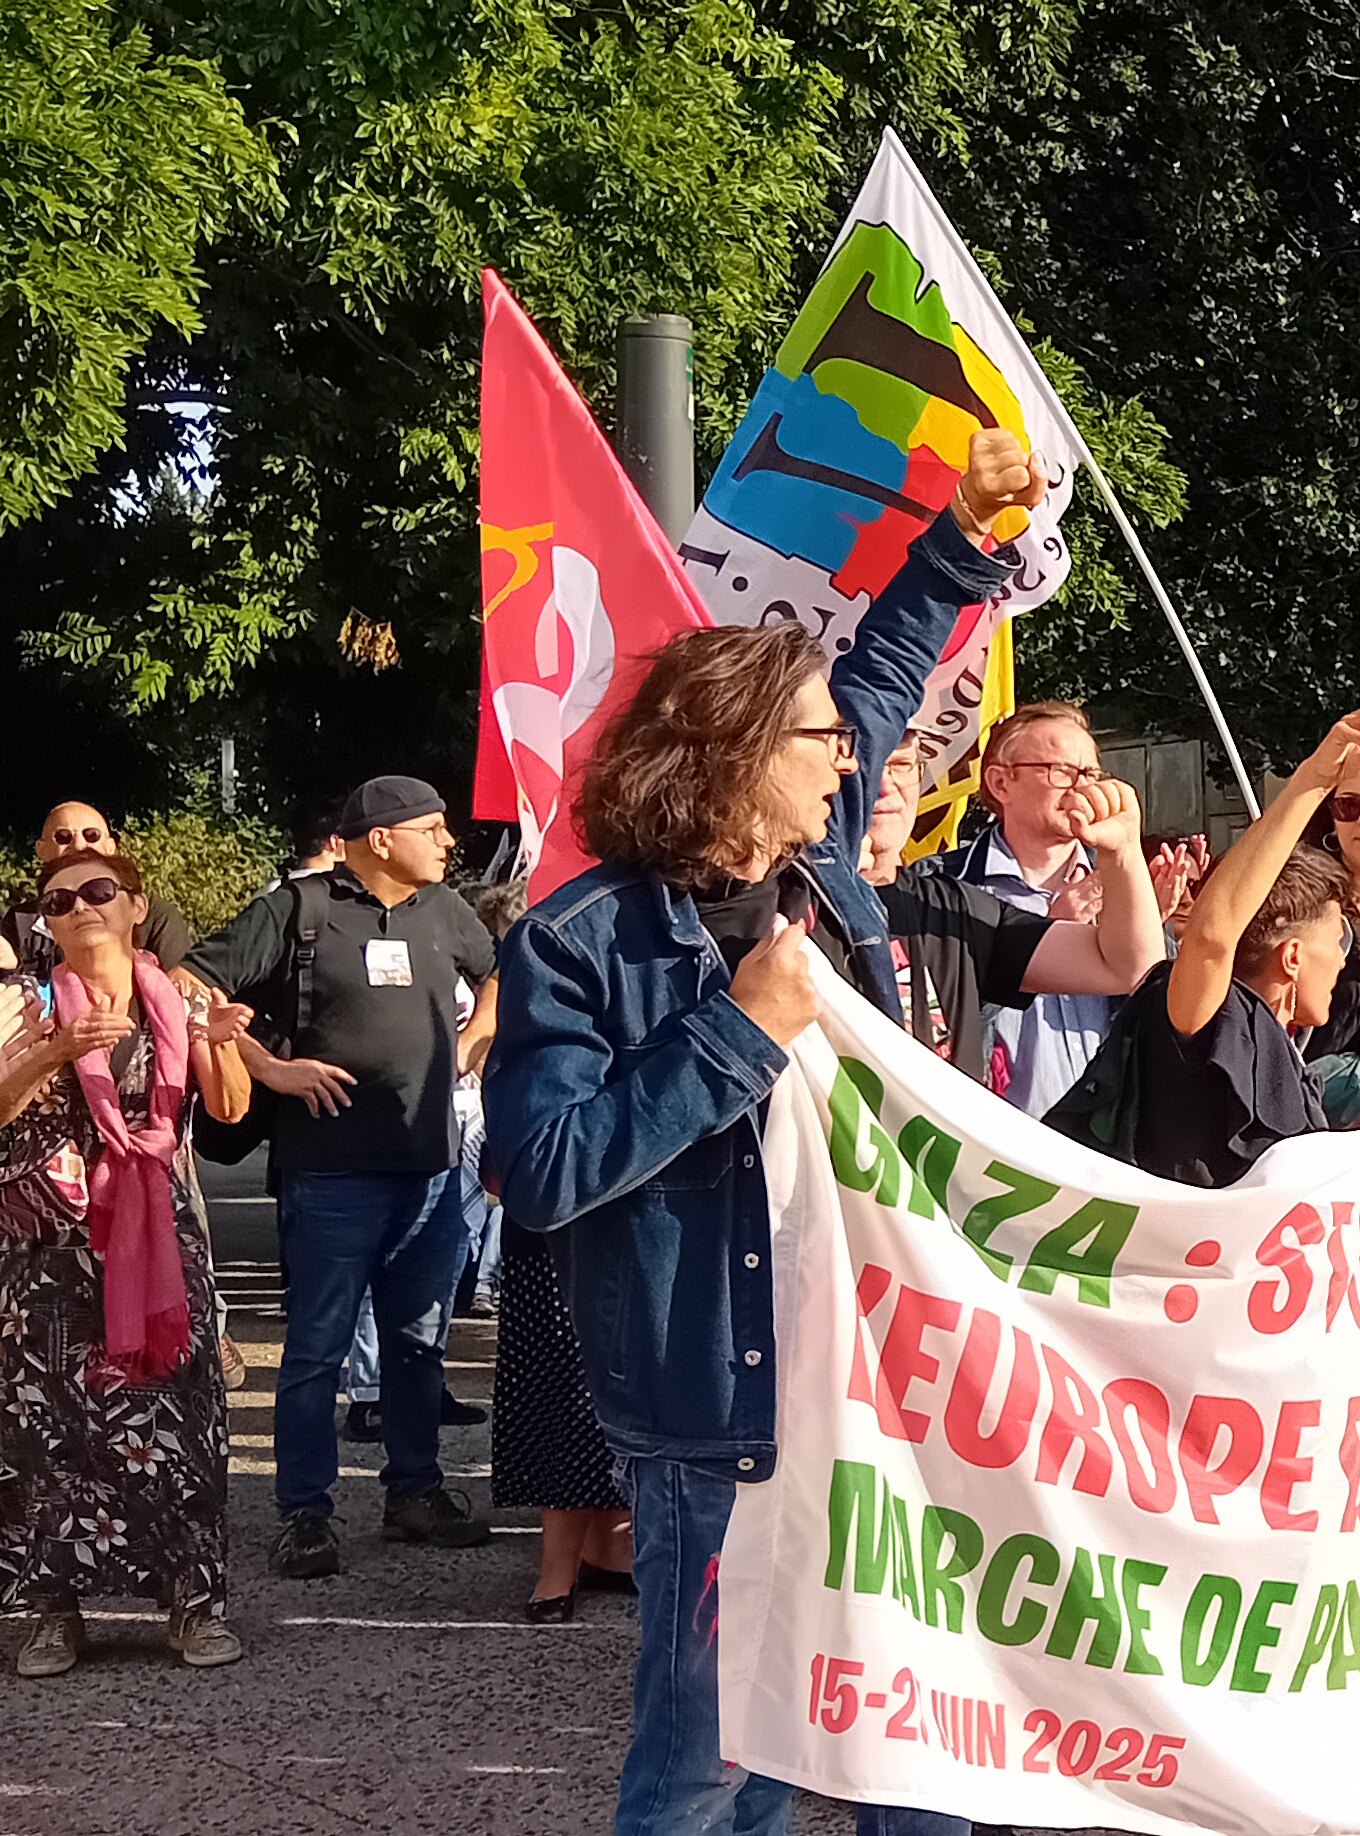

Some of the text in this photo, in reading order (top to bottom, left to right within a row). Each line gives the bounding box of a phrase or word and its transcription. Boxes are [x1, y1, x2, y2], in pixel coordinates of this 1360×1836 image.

[828, 1056, 1139, 1309] GAZA
[824, 1459, 1168, 1675] MARCHE
[1180, 1571, 1297, 1694] DE
[1022, 1706, 1186, 1788] 2025
